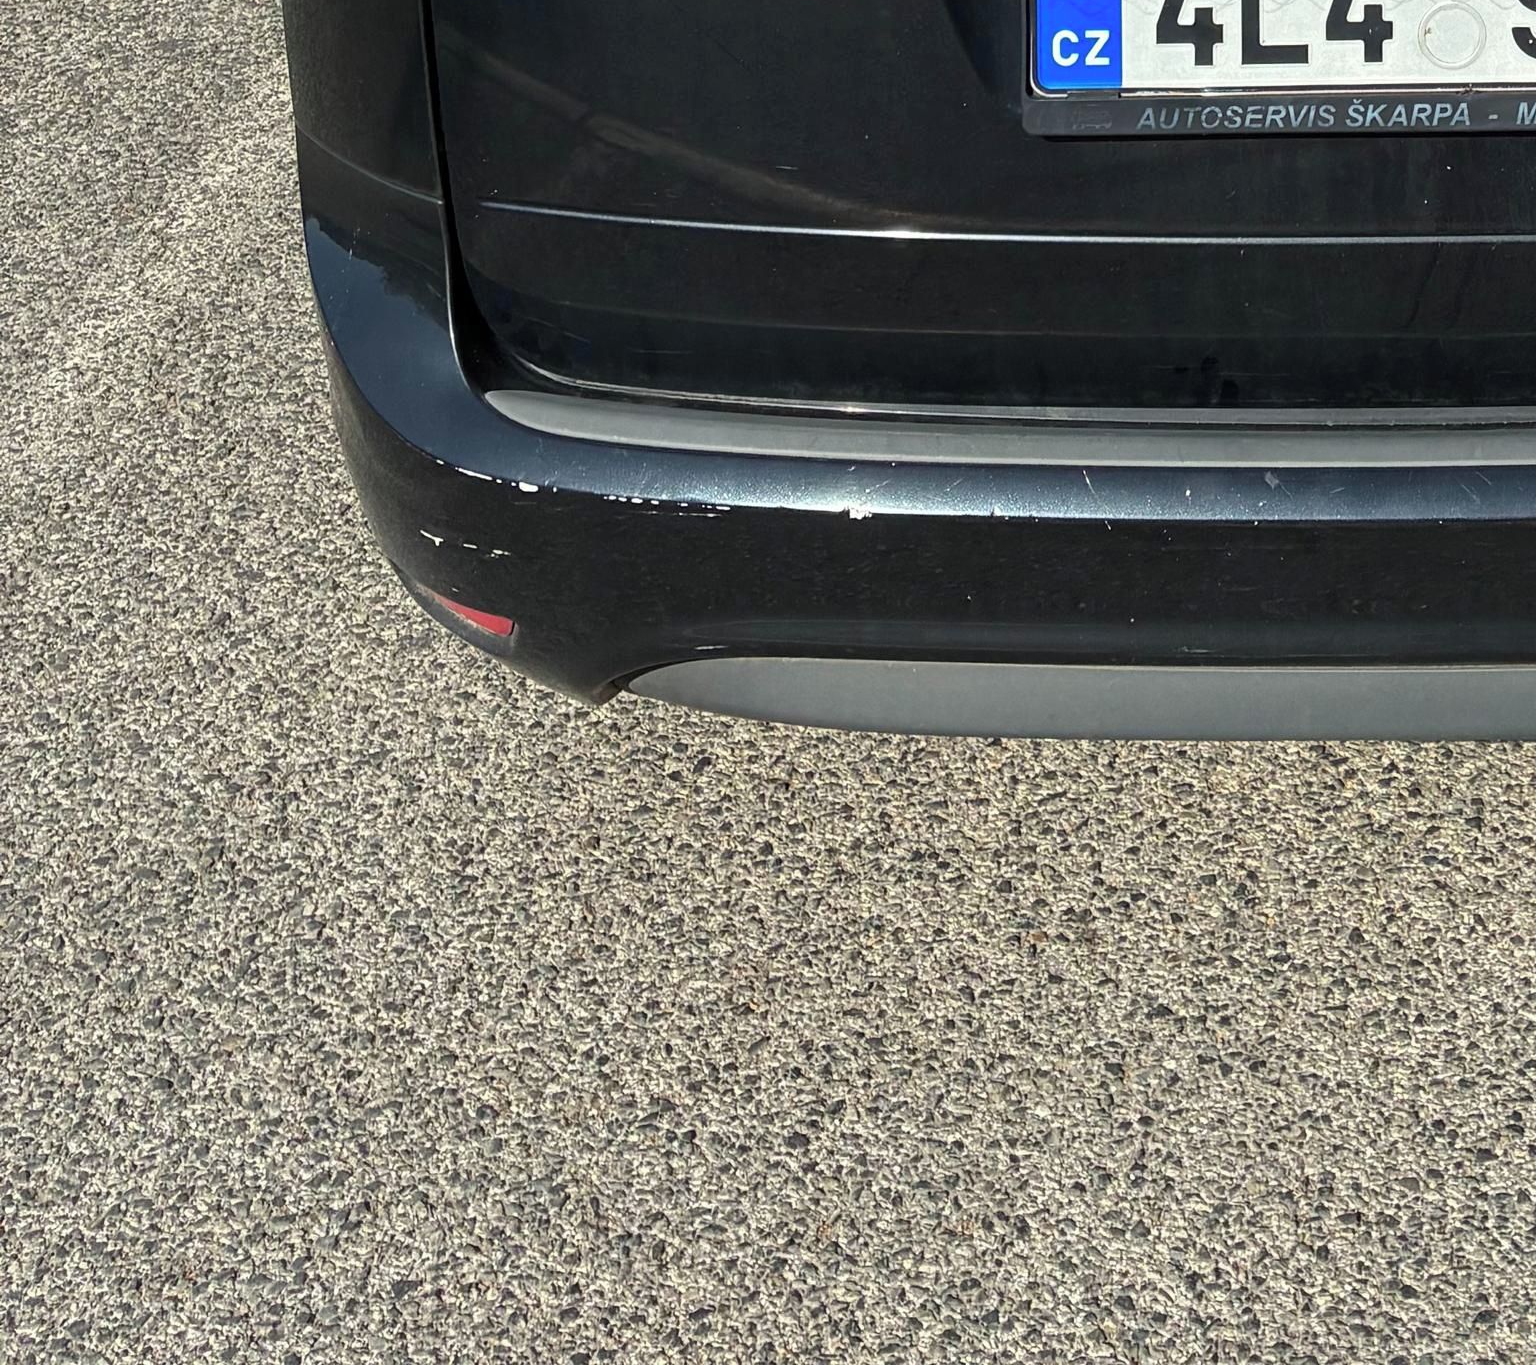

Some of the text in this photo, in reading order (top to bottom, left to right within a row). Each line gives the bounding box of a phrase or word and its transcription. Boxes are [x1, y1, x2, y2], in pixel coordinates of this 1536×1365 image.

[1051, 29, 1111, 67] CZ
[1135, 105, 1336, 131] AUTOSERVIS
[1344, 100, 1472, 127] ŠKARPA
